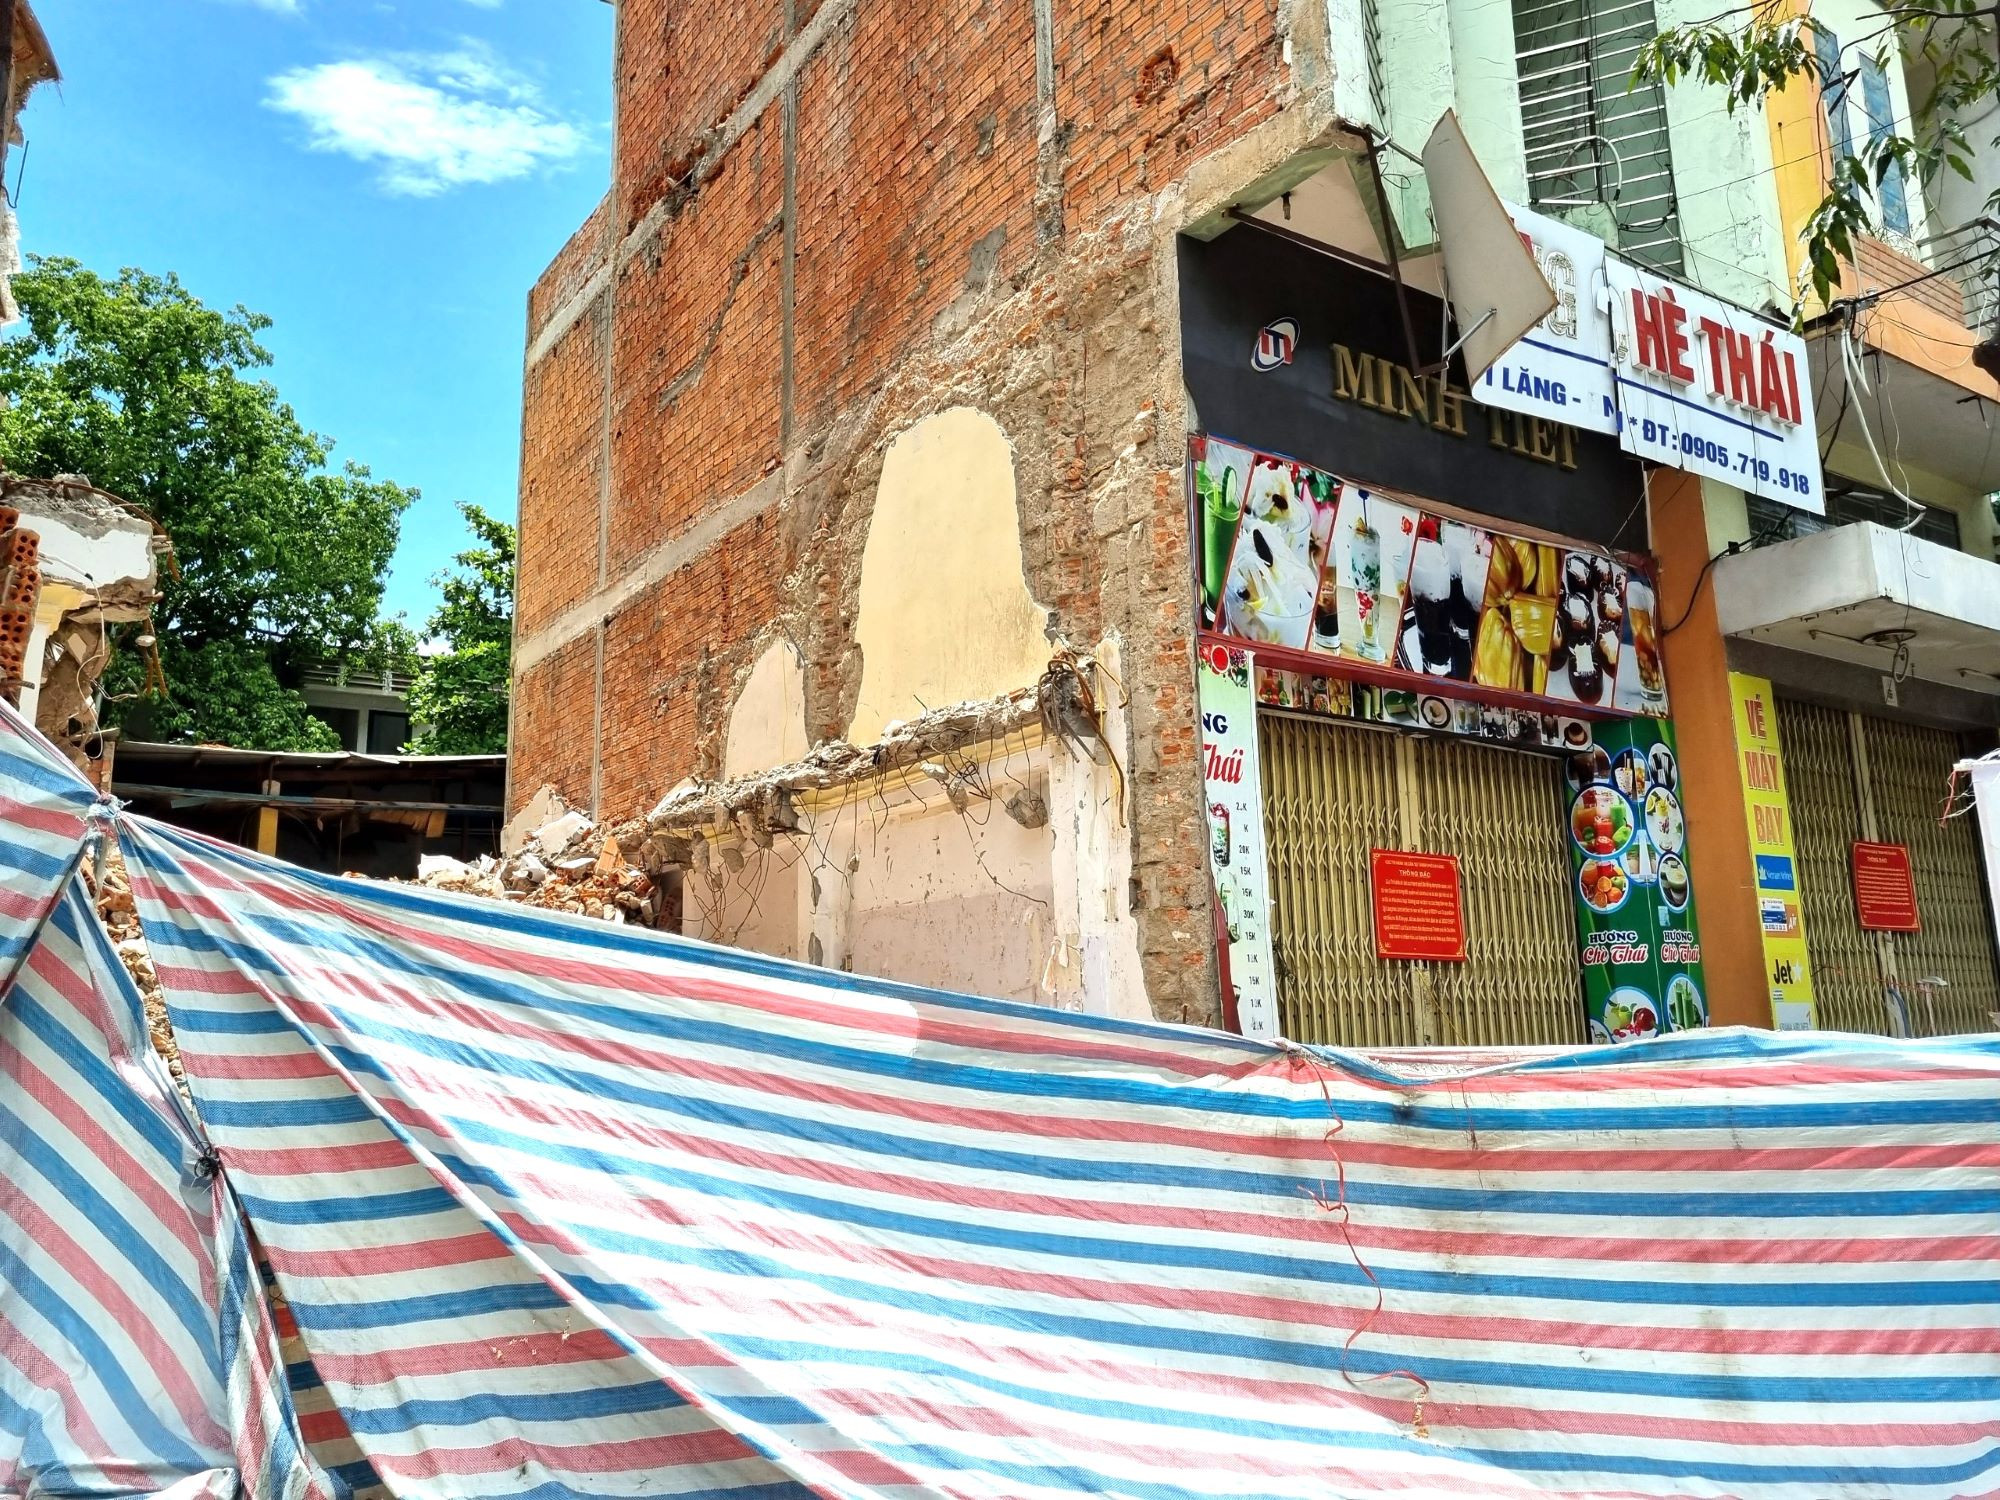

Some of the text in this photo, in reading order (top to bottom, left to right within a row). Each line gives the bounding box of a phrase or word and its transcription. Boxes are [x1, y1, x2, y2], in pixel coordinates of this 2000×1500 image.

[1693, 315, 1803, 428] THÁI
[1331, 343, 1468, 436] MINH
[1502, 366, 1567, 406] LĂNG
[1754, 804, 1784, 846] BAY
[1240, 866, 1251, 876] 15K
[1589, 930, 1638, 944] HƯƠNG
[1663, 930, 1693, 943] HƯƠNG
[1583, 944, 1648, 965] Chè Thái
[1661, 944, 1678, 963] Chè
